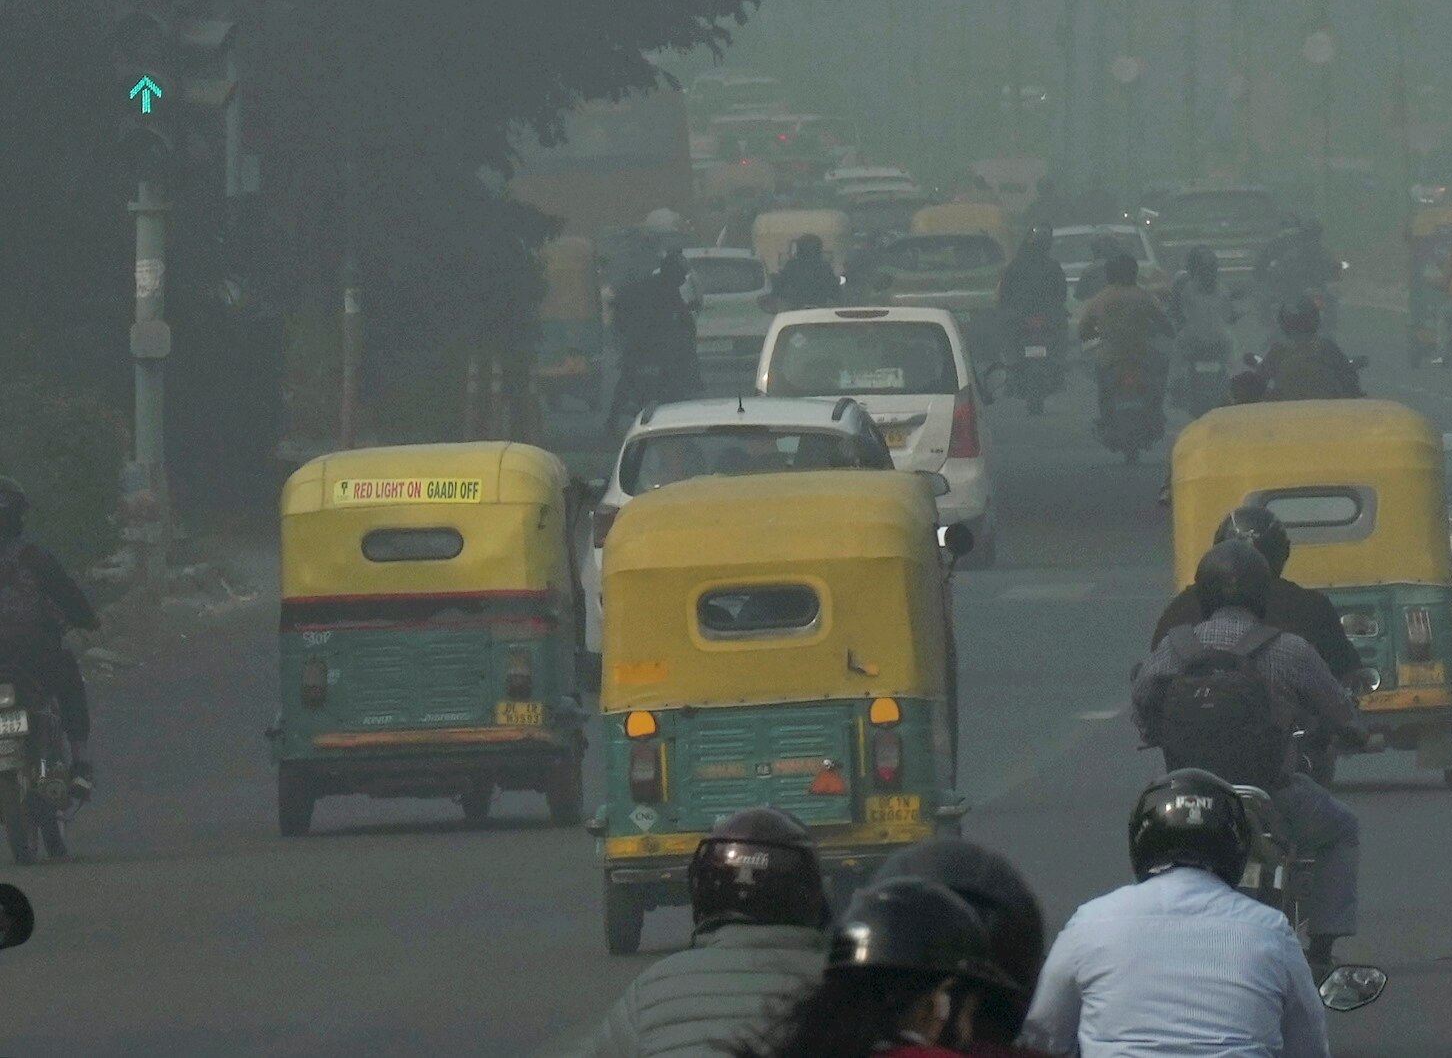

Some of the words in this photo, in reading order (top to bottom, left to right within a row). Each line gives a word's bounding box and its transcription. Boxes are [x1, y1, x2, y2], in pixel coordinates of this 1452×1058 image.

[354, 482, 373, 500] RED
[375, 481, 405, 499] LIGHT
[407, 481, 422, 499] ON
[427, 481, 457, 499] GAADI
[460, 481, 480, 500] OFF
